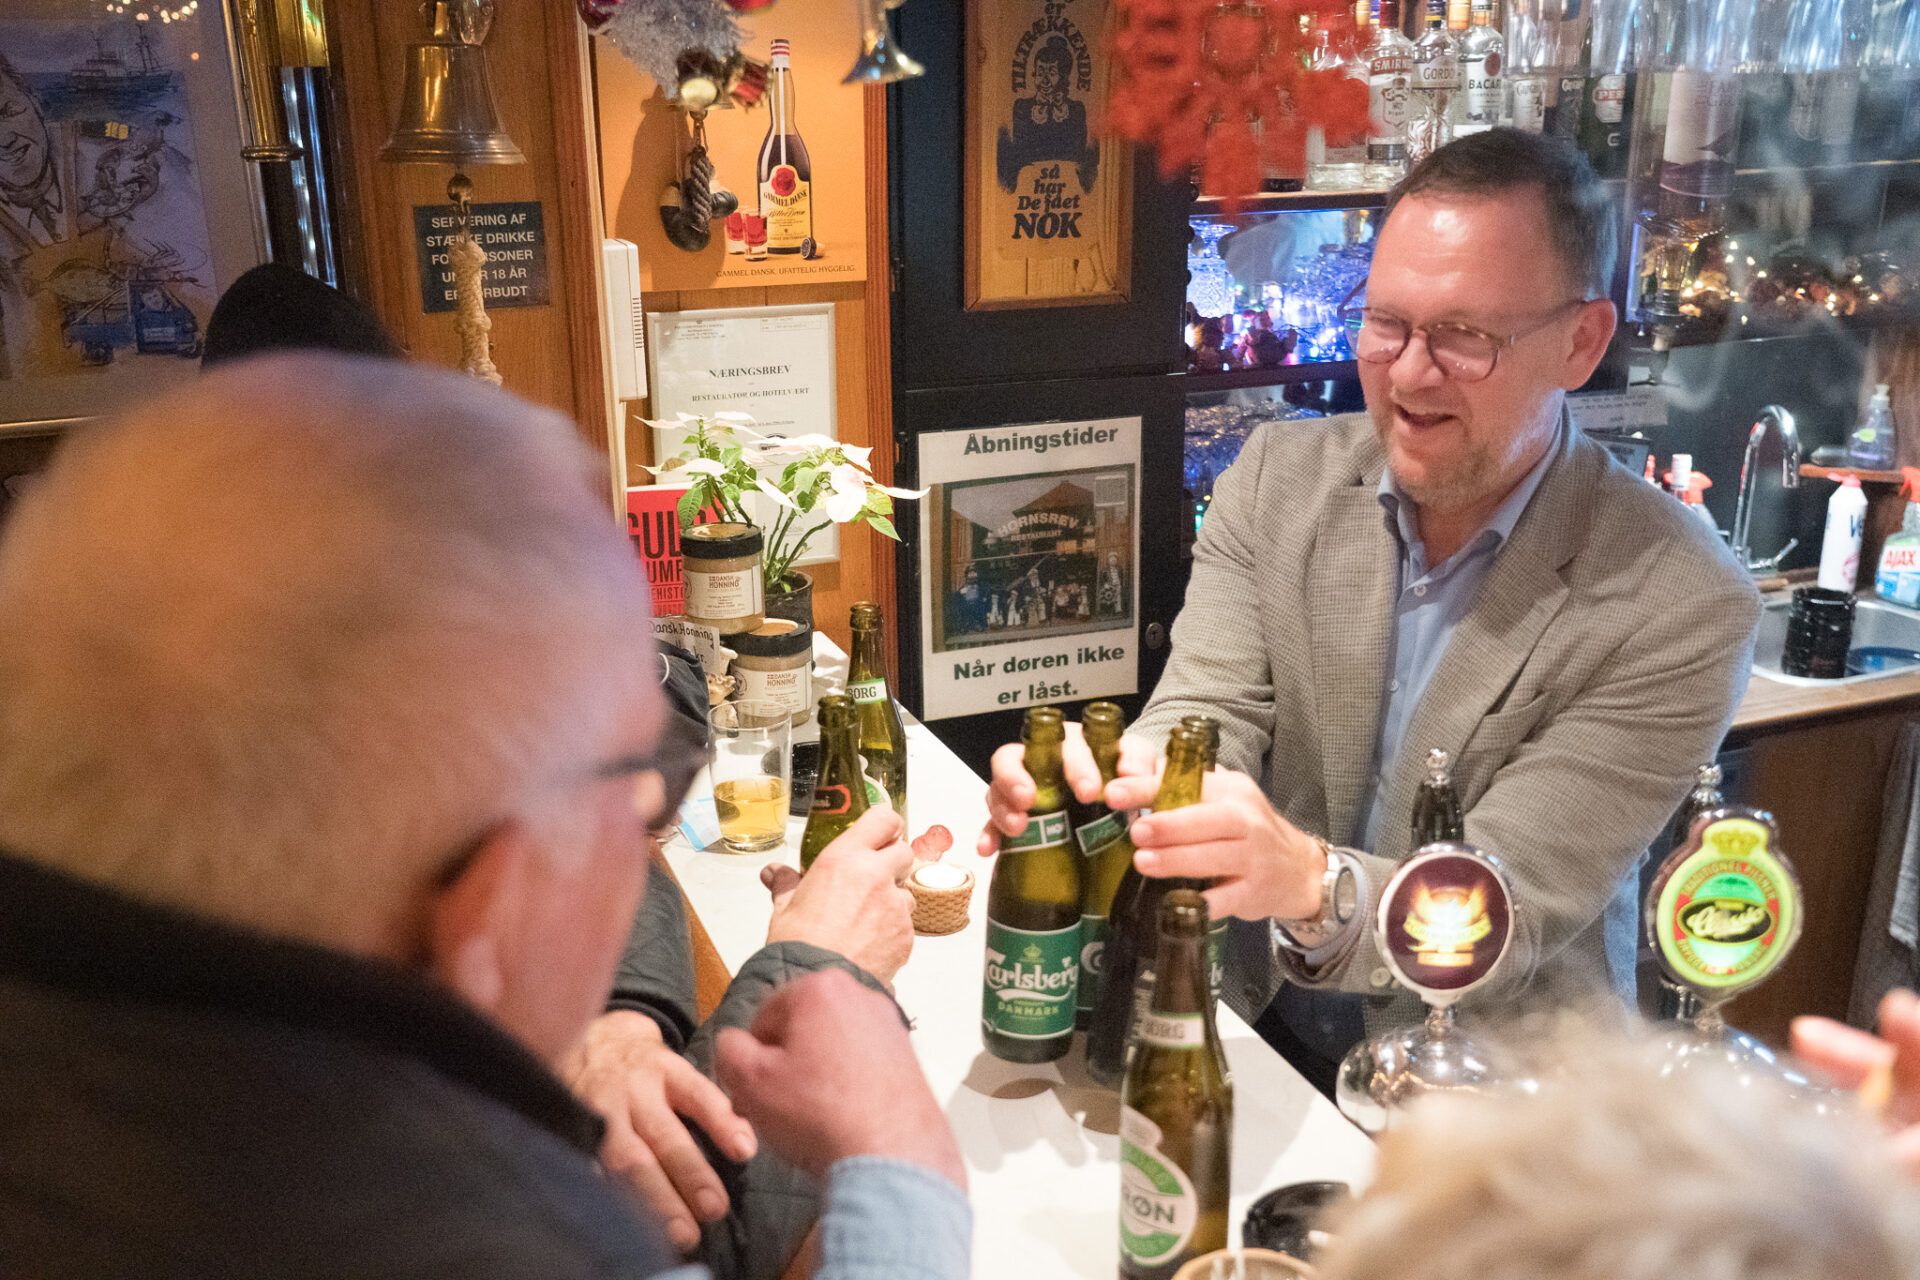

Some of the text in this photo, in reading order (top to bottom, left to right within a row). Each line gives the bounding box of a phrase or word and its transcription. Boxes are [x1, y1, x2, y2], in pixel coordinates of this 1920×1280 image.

[1034, 178, 1067, 194] har
[1017, 196, 1041, 210] De
[510, 213, 527, 224] AF
[1012, 212, 1082, 239] NOK
[486, 231, 536, 244] DRIKKE
[492, 270, 506, 281] 18
[510, 265, 527, 279] ÅR
[716, 269, 749, 278] GAMMEL
[709, 364, 792, 379] NÆRINGSBREV
[749, 390, 761, 398] OG
[964, 426, 1118, 455] Åbningstider
[998, 512, 1080, 538] HORNSREV
[1885, 550, 1916, 568] AJAX
[954, 645, 1125, 680] Når døren ikke
[997, 680, 1078, 705] er låst.
[984, 946, 1080, 1001] Carlsberg
[998, 1001, 1060, 1017] DANMARK
